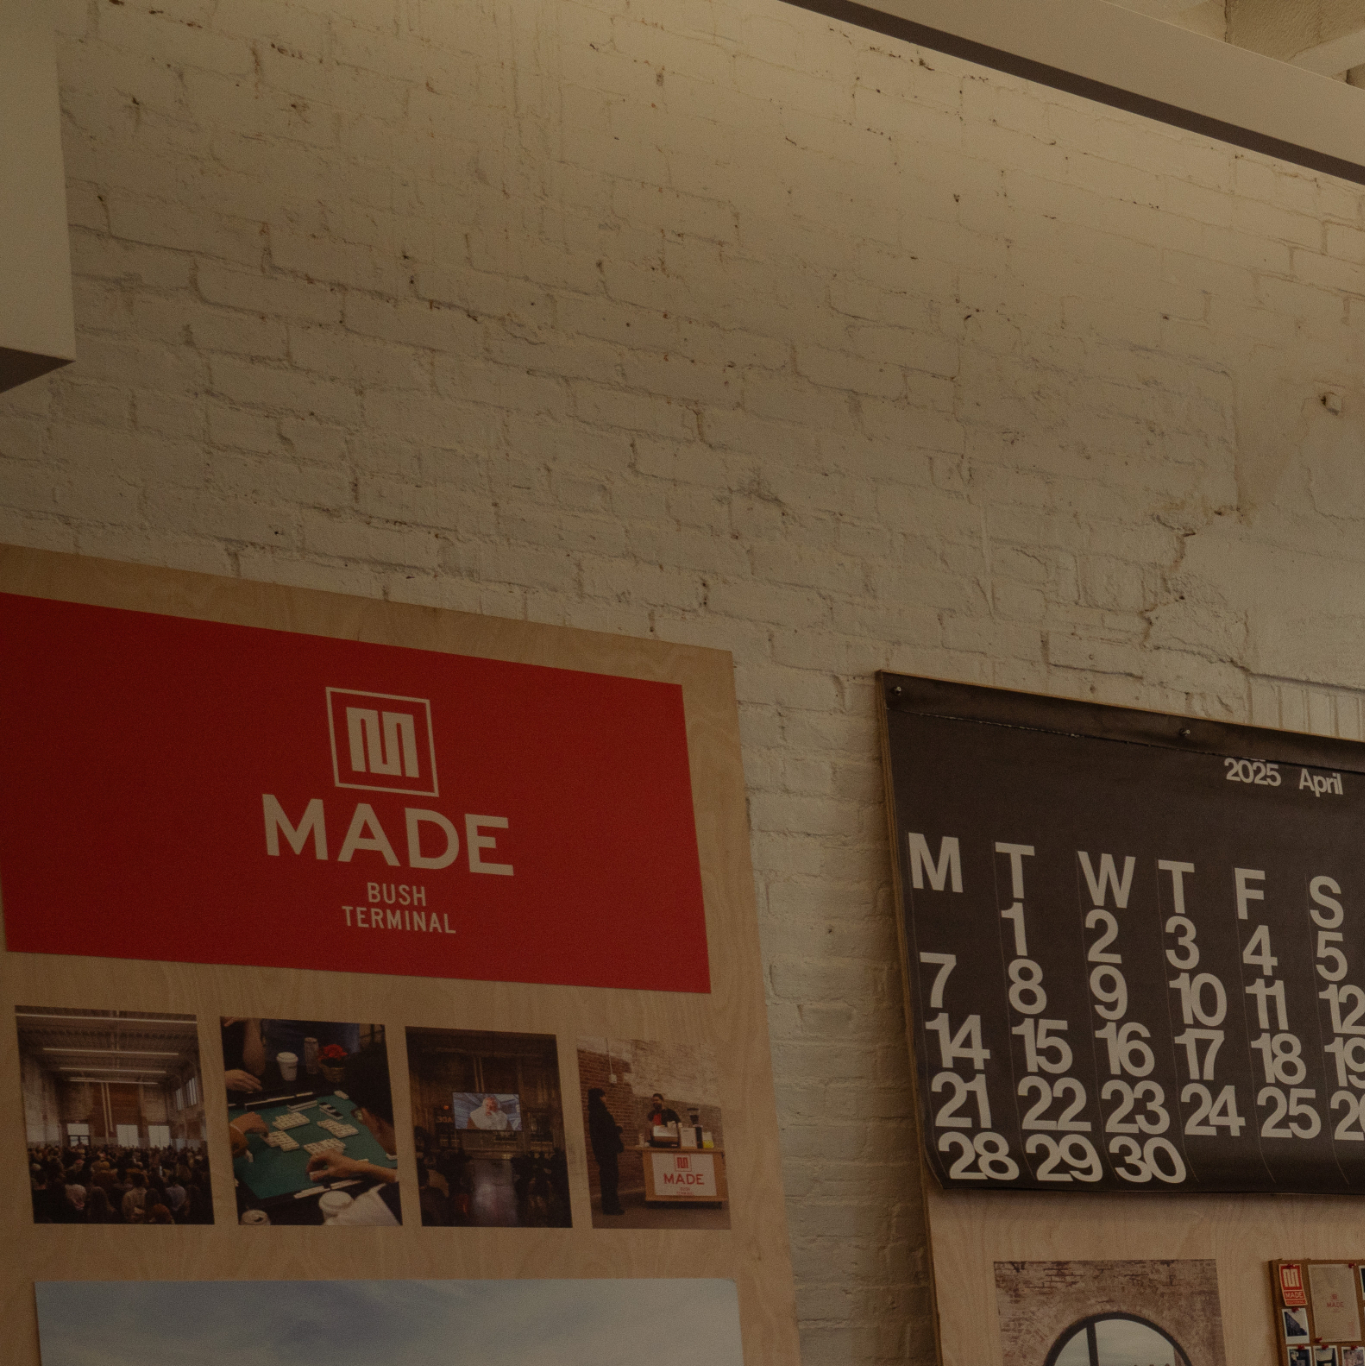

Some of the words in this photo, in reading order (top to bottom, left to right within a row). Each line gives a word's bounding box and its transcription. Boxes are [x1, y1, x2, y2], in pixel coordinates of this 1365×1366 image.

[1224, 757, 1282, 787] 2025
[1299, 768, 1344, 798] April
[261, 793, 514, 876] MADE
[366, 881, 427, 907] BUSH
[908, 832, 963, 893] M
[995, 841, 1035, 899] T
[1077, 850, 1136, 909] W
[1157, 859, 1195, 915] T
[1234, 867, 1266, 920] F
[1308, 875, 1345, 930] S
[341, 905, 457, 934] TERMINAL
[1000, 901, 1028, 957] 1
[1085, 908, 1123, 964] 2
[1165, 915, 1200, 970] 3
[1242, 924, 1279, 976] 4
[1315, 930, 1349, 982] 5
[919, 951, 957, 1008] 7
[1008, 958, 1047, 1015] 8
[1089, 964, 1128, 1021] 9
[1168, 972, 1228, 1027] 10
[1244, 977, 1289, 1031] 11
[925, 1012, 991, 1070] 14
[1011, 1017, 1073, 1074] 15
[1094, 1021, 1156, 1078] 16
[1173, 1027, 1225, 1081] 17
[1250, 1032, 1307, 1086] 18
[931, 1071, 992, 1129] 21
[1017, 1075, 1092, 1132] 22
[1101, 1079, 1171, 1135] 23
[1180, 1082, 1246, 1137] 24
[1256, 1085, 1322, 1140] 25
[663, 1172, 705, 1186] MADE
[938, 1131, 1020, 1181] 28
[1025, 1133, 1103, 1182] 29
[1108, 1135, 1187, 1184] 30
[1285, 1291, 1304, 1299] MADE
